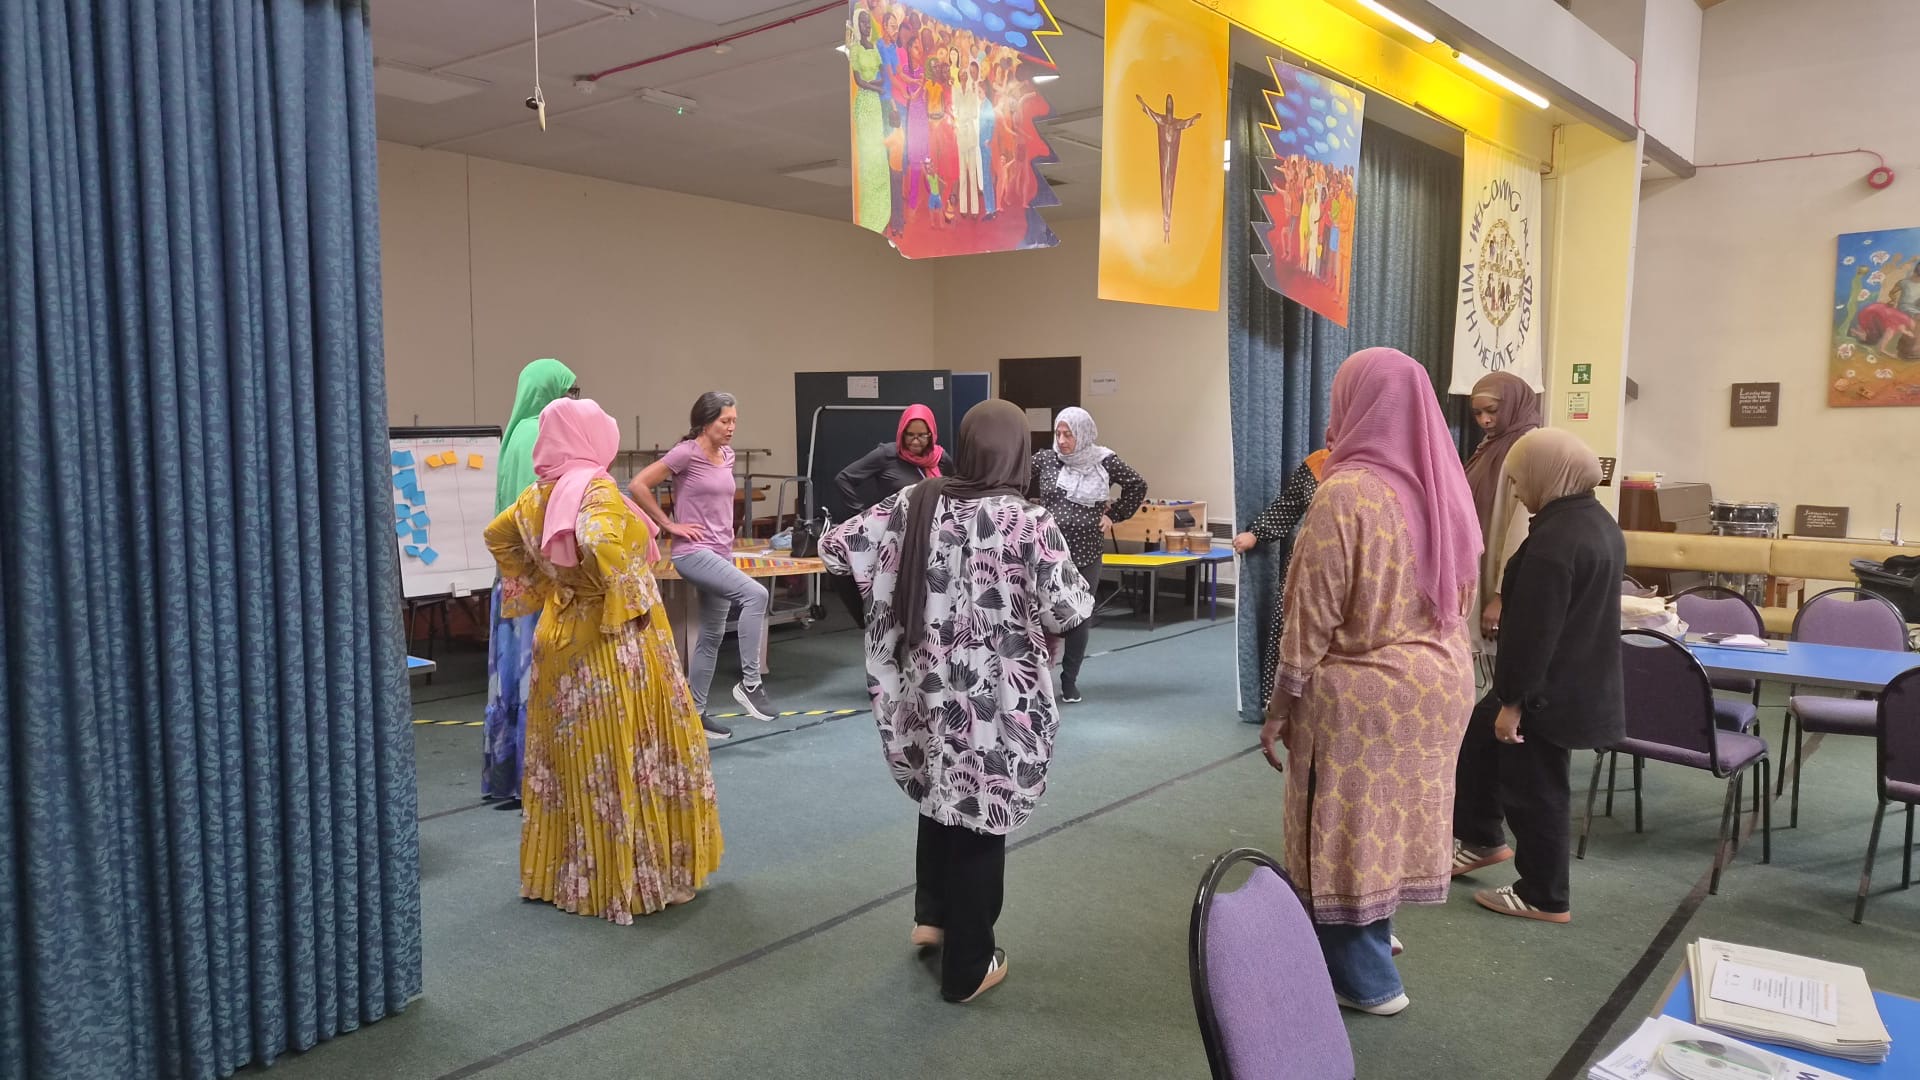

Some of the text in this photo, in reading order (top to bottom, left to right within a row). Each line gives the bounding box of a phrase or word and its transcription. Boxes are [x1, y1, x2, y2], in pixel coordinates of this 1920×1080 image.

[1470, 178, 1521, 243] WELCOMNG
[1461, 263, 1478, 332] WITH
[1490, 342, 1515, 372] LOVE
[1519, 275, 1533, 345] JESUS
